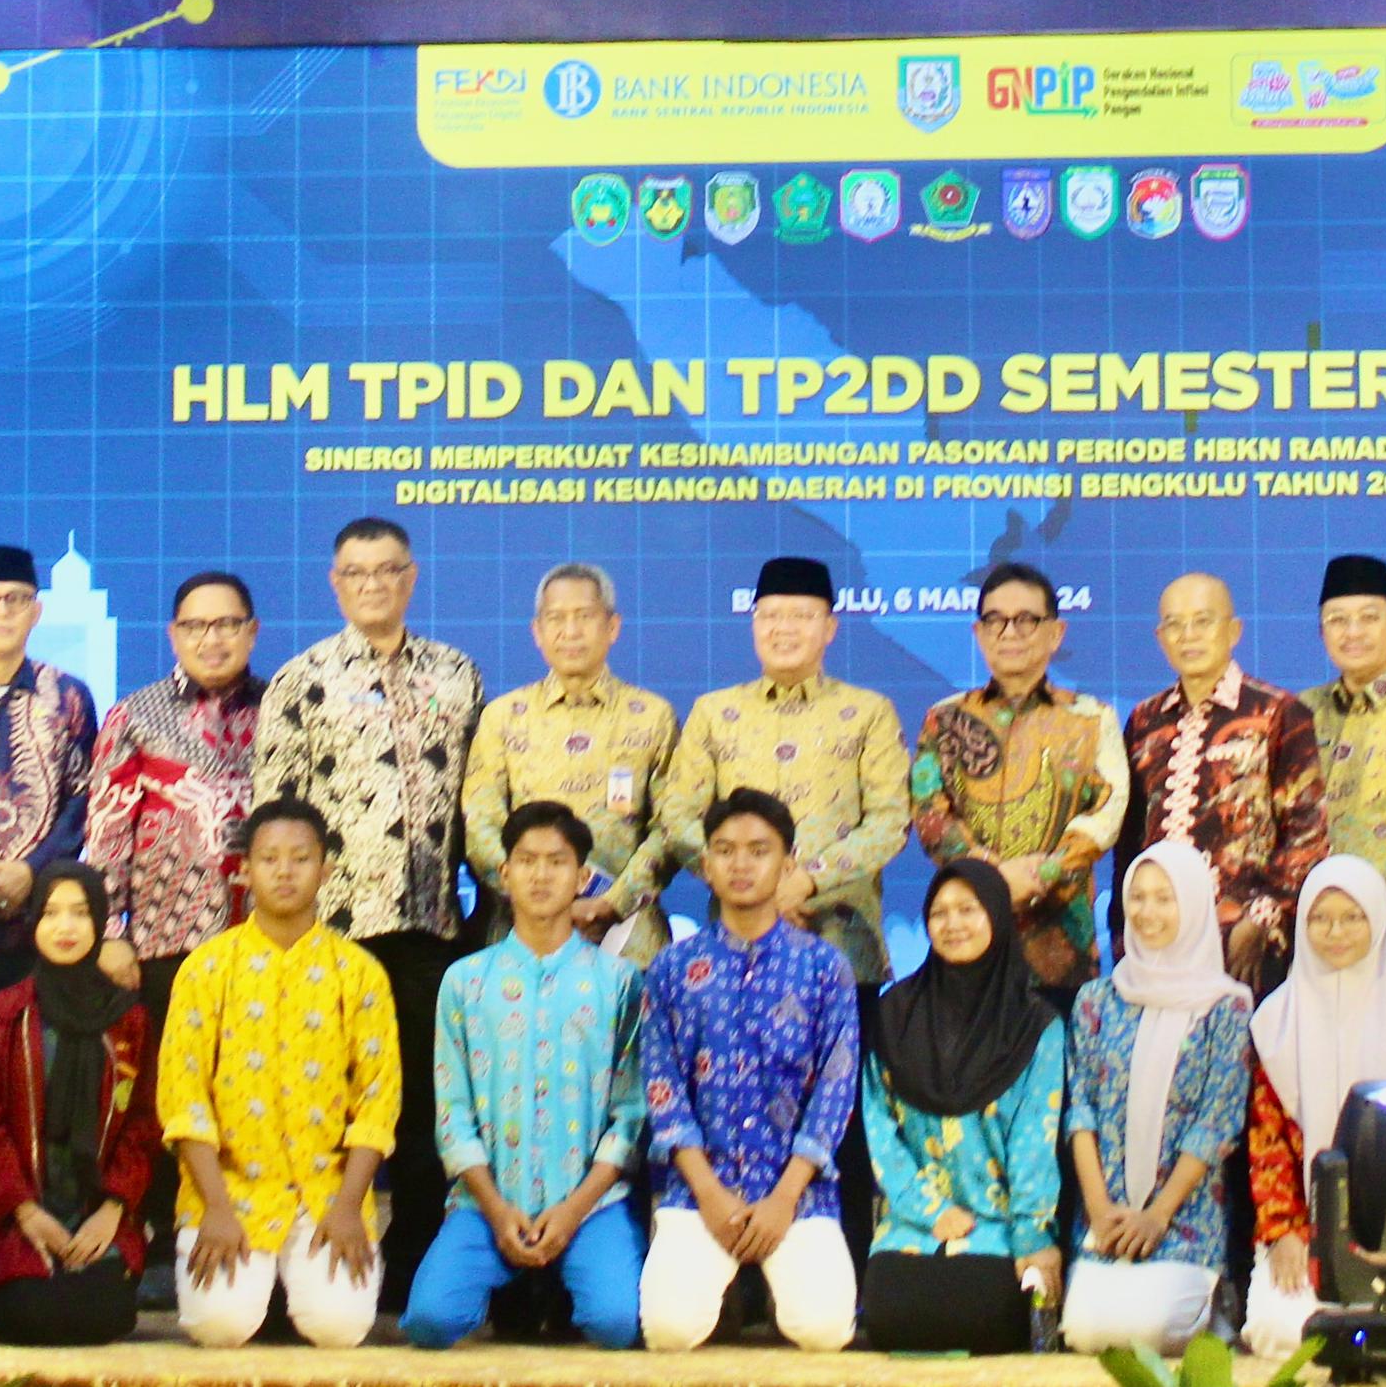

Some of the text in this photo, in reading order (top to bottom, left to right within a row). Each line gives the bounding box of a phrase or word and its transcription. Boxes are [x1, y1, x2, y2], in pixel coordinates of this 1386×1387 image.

[612, 71, 870, 101] BANK INDONESIA
[173, 363, 329, 422] HLM
[349, 360, 522, 421] TPID
[543, 358, 705, 418] DAN
[726, 355, 981, 415] TP2DD
[305, 446, 422, 472] SINERGI
[429, 444, 633, 471] MEMPERKUAT
[640, 441, 899, 468] KESINAMBUNGAN
[908, 439, 1050, 465] PASOKAN
[1056, 438, 1186, 464] PERIODE
[1194, 437, 1282, 463] HBKN
[396, 478, 586, 505] DIGITALISASI
[593, 477, 759, 503] KEUANGAN
[766, 475, 886, 501] DAERAH
[895, 475, 925, 500] DI
[933, 474, 1073, 500] PROVINSI
[1080, 472, 1247, 499] BENGKULU
[1254, 471, 1360, 497] TAHUN
[893, 586, 912, 612] 6
[918, 586, 981, 611] MAR
[1056, 585, 1093, 611] 24
